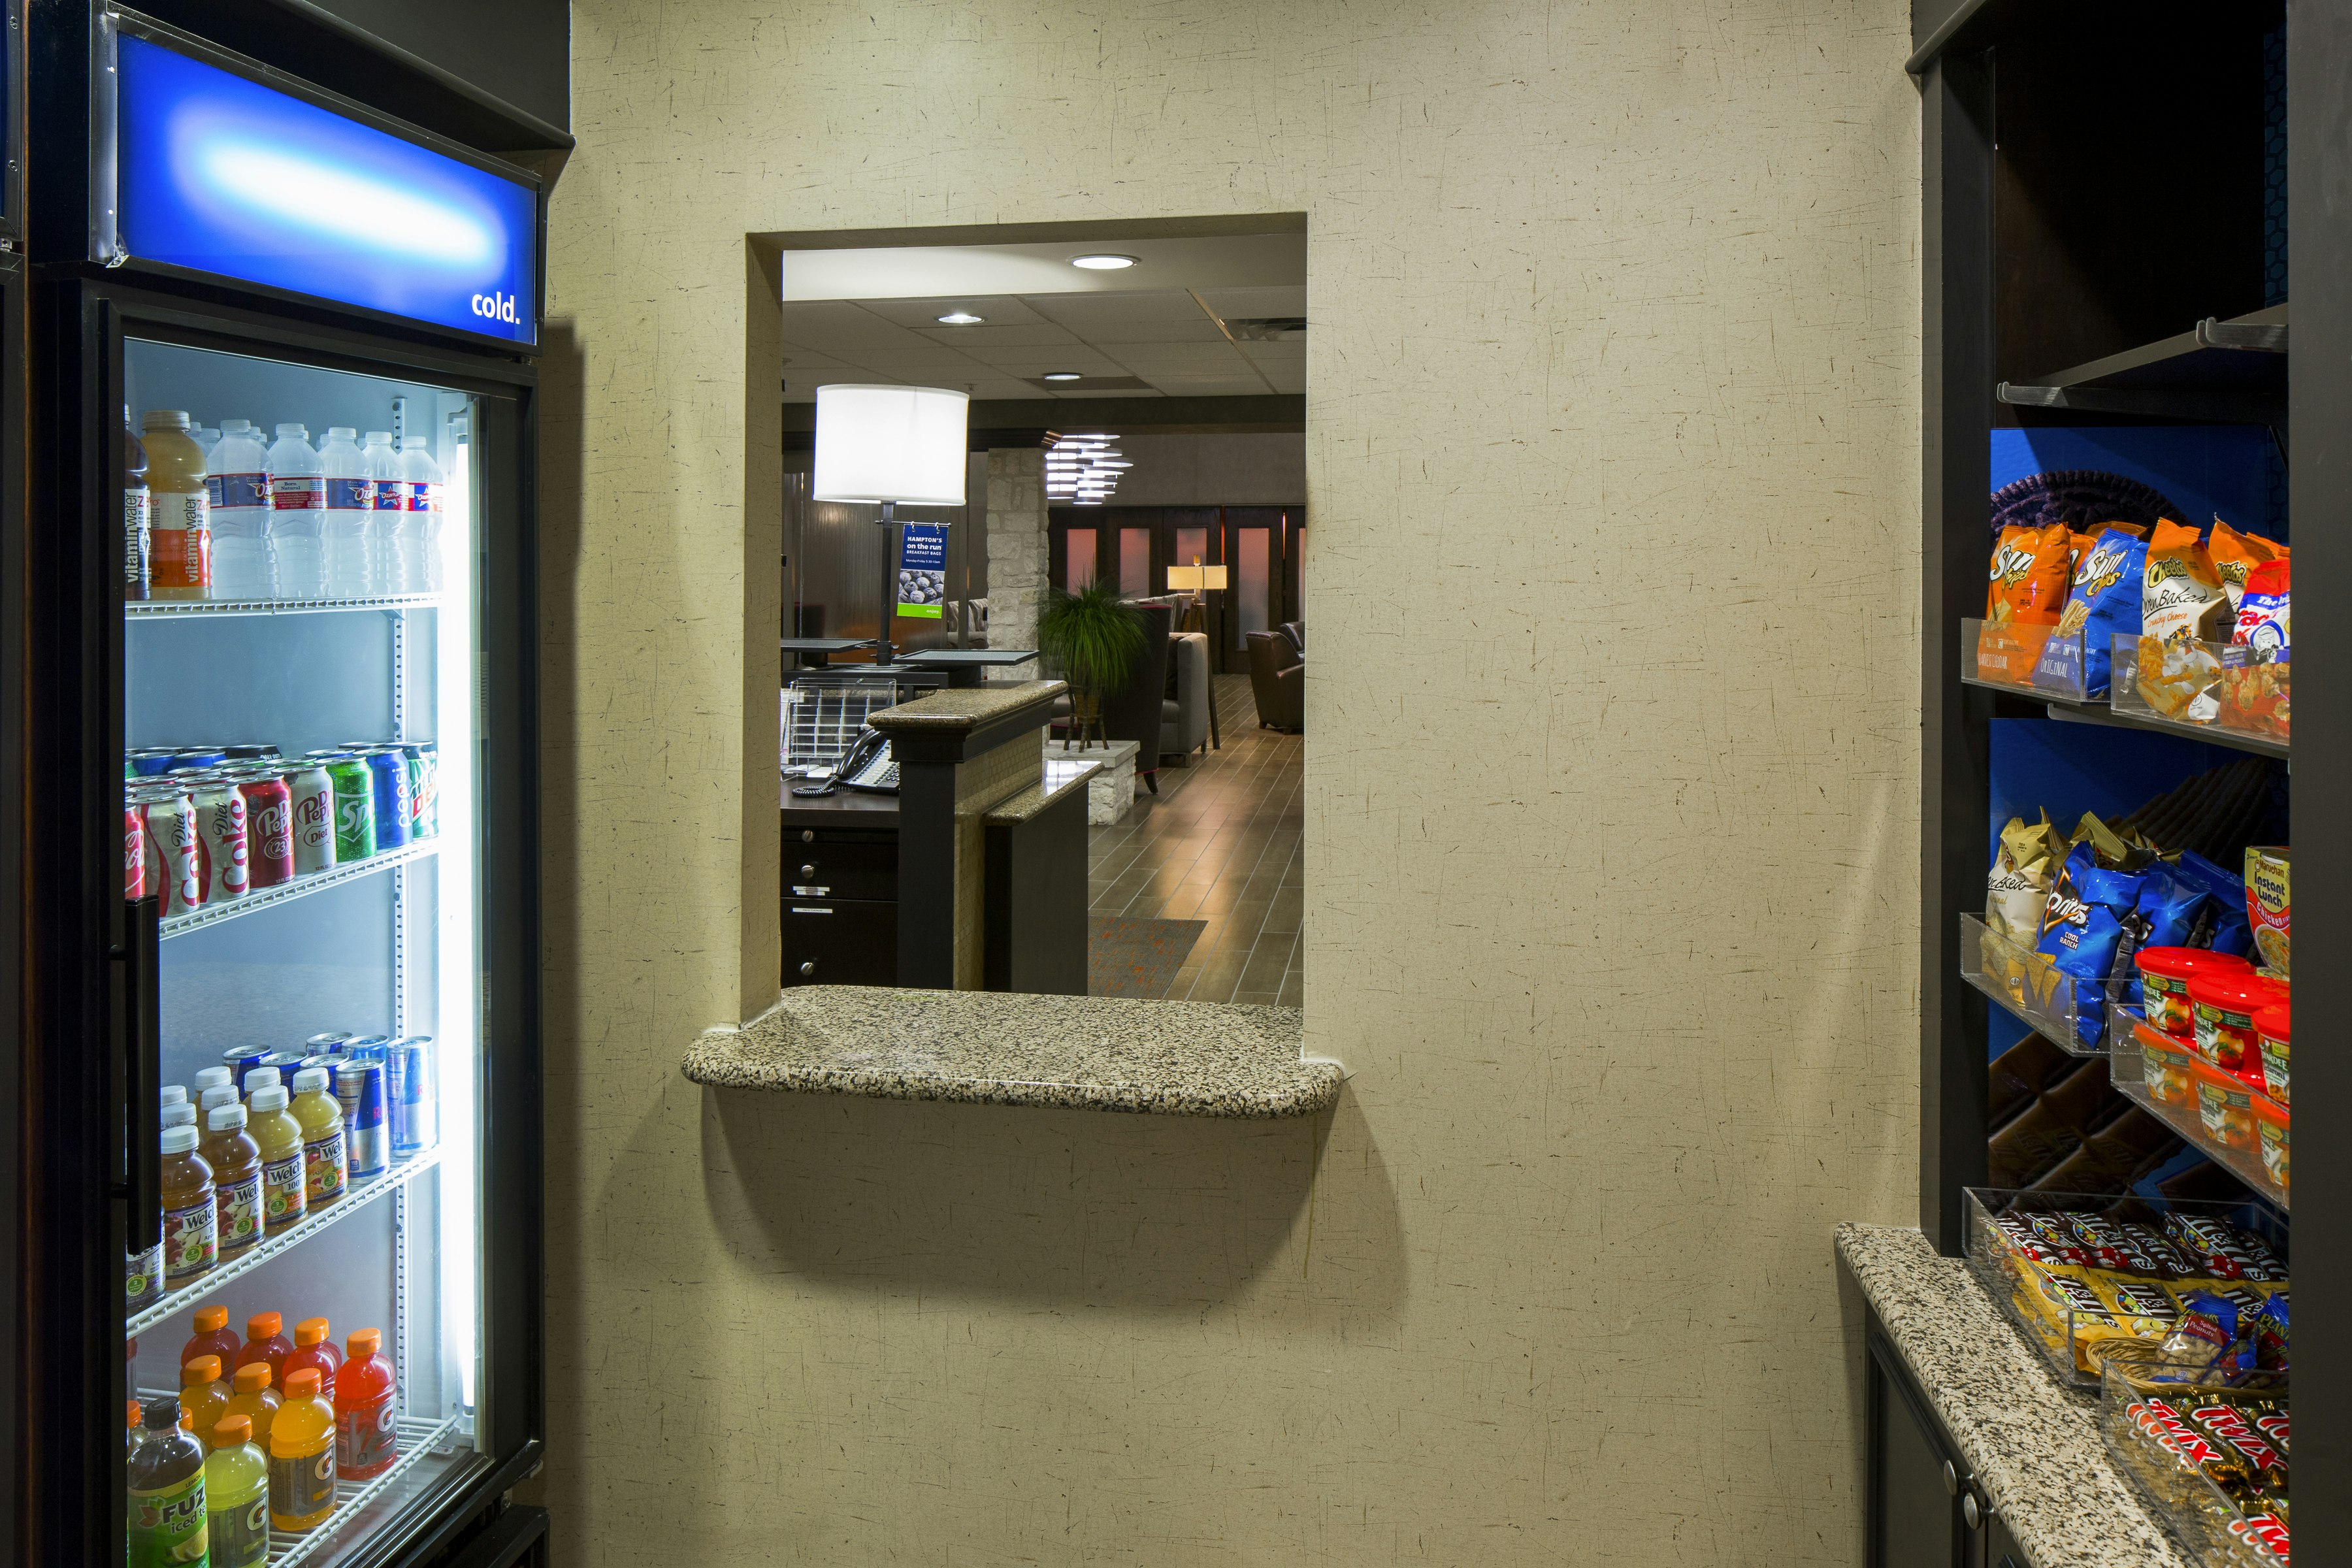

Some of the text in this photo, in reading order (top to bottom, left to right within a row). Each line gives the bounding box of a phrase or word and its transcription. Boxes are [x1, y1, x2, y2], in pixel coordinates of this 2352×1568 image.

[472, 291, 520, 324] cold.
[125, 492, 139, 583] vitaminwater
[183, 497, 199, 582] vitaminwater
[2074, 549, 2127, 585] Sun
[2148, 557, 2187, 589] Cheetos
[2159, 587, 2210, 606] Baked
[2257, 596, 2278, 606] The
[2148, 612, 2187, 628] Crunchy Cheese
[2040, 658, 2067, 678] ORIGINAL
[392, 766, 412, 828] pepsi
[171, 812, 186, 847] Diet
[213, 802, 228, 836] Diet
[222, 800, 248, 893] Coke
[274, 841, 286, 853] 23
[310, 828, 328, 843] Diet
[181, 809, 199, 906] Coke
[2260, 860, 2284, 878] Maruchan
[2255, 871, 2285, 896] Instant
[2258, 886, 2283, 908] Lunch
[2257, 902, 2283, 926] Chicken
[2060, 938, 2078, 949] RANCH
[2065, 932, 2079, 943] COOL
[2189, 1320, 2215, 1337] Peanuts
[2200, 1320, 2217, 1332] Salted
[2126, 1397, 2223, 1469] TWIX
[2191, 1405, 2289, 1470] TWIX
[185, 1475, 201, 1488] LEMON
[171, 1512, 197, 1534] iced
